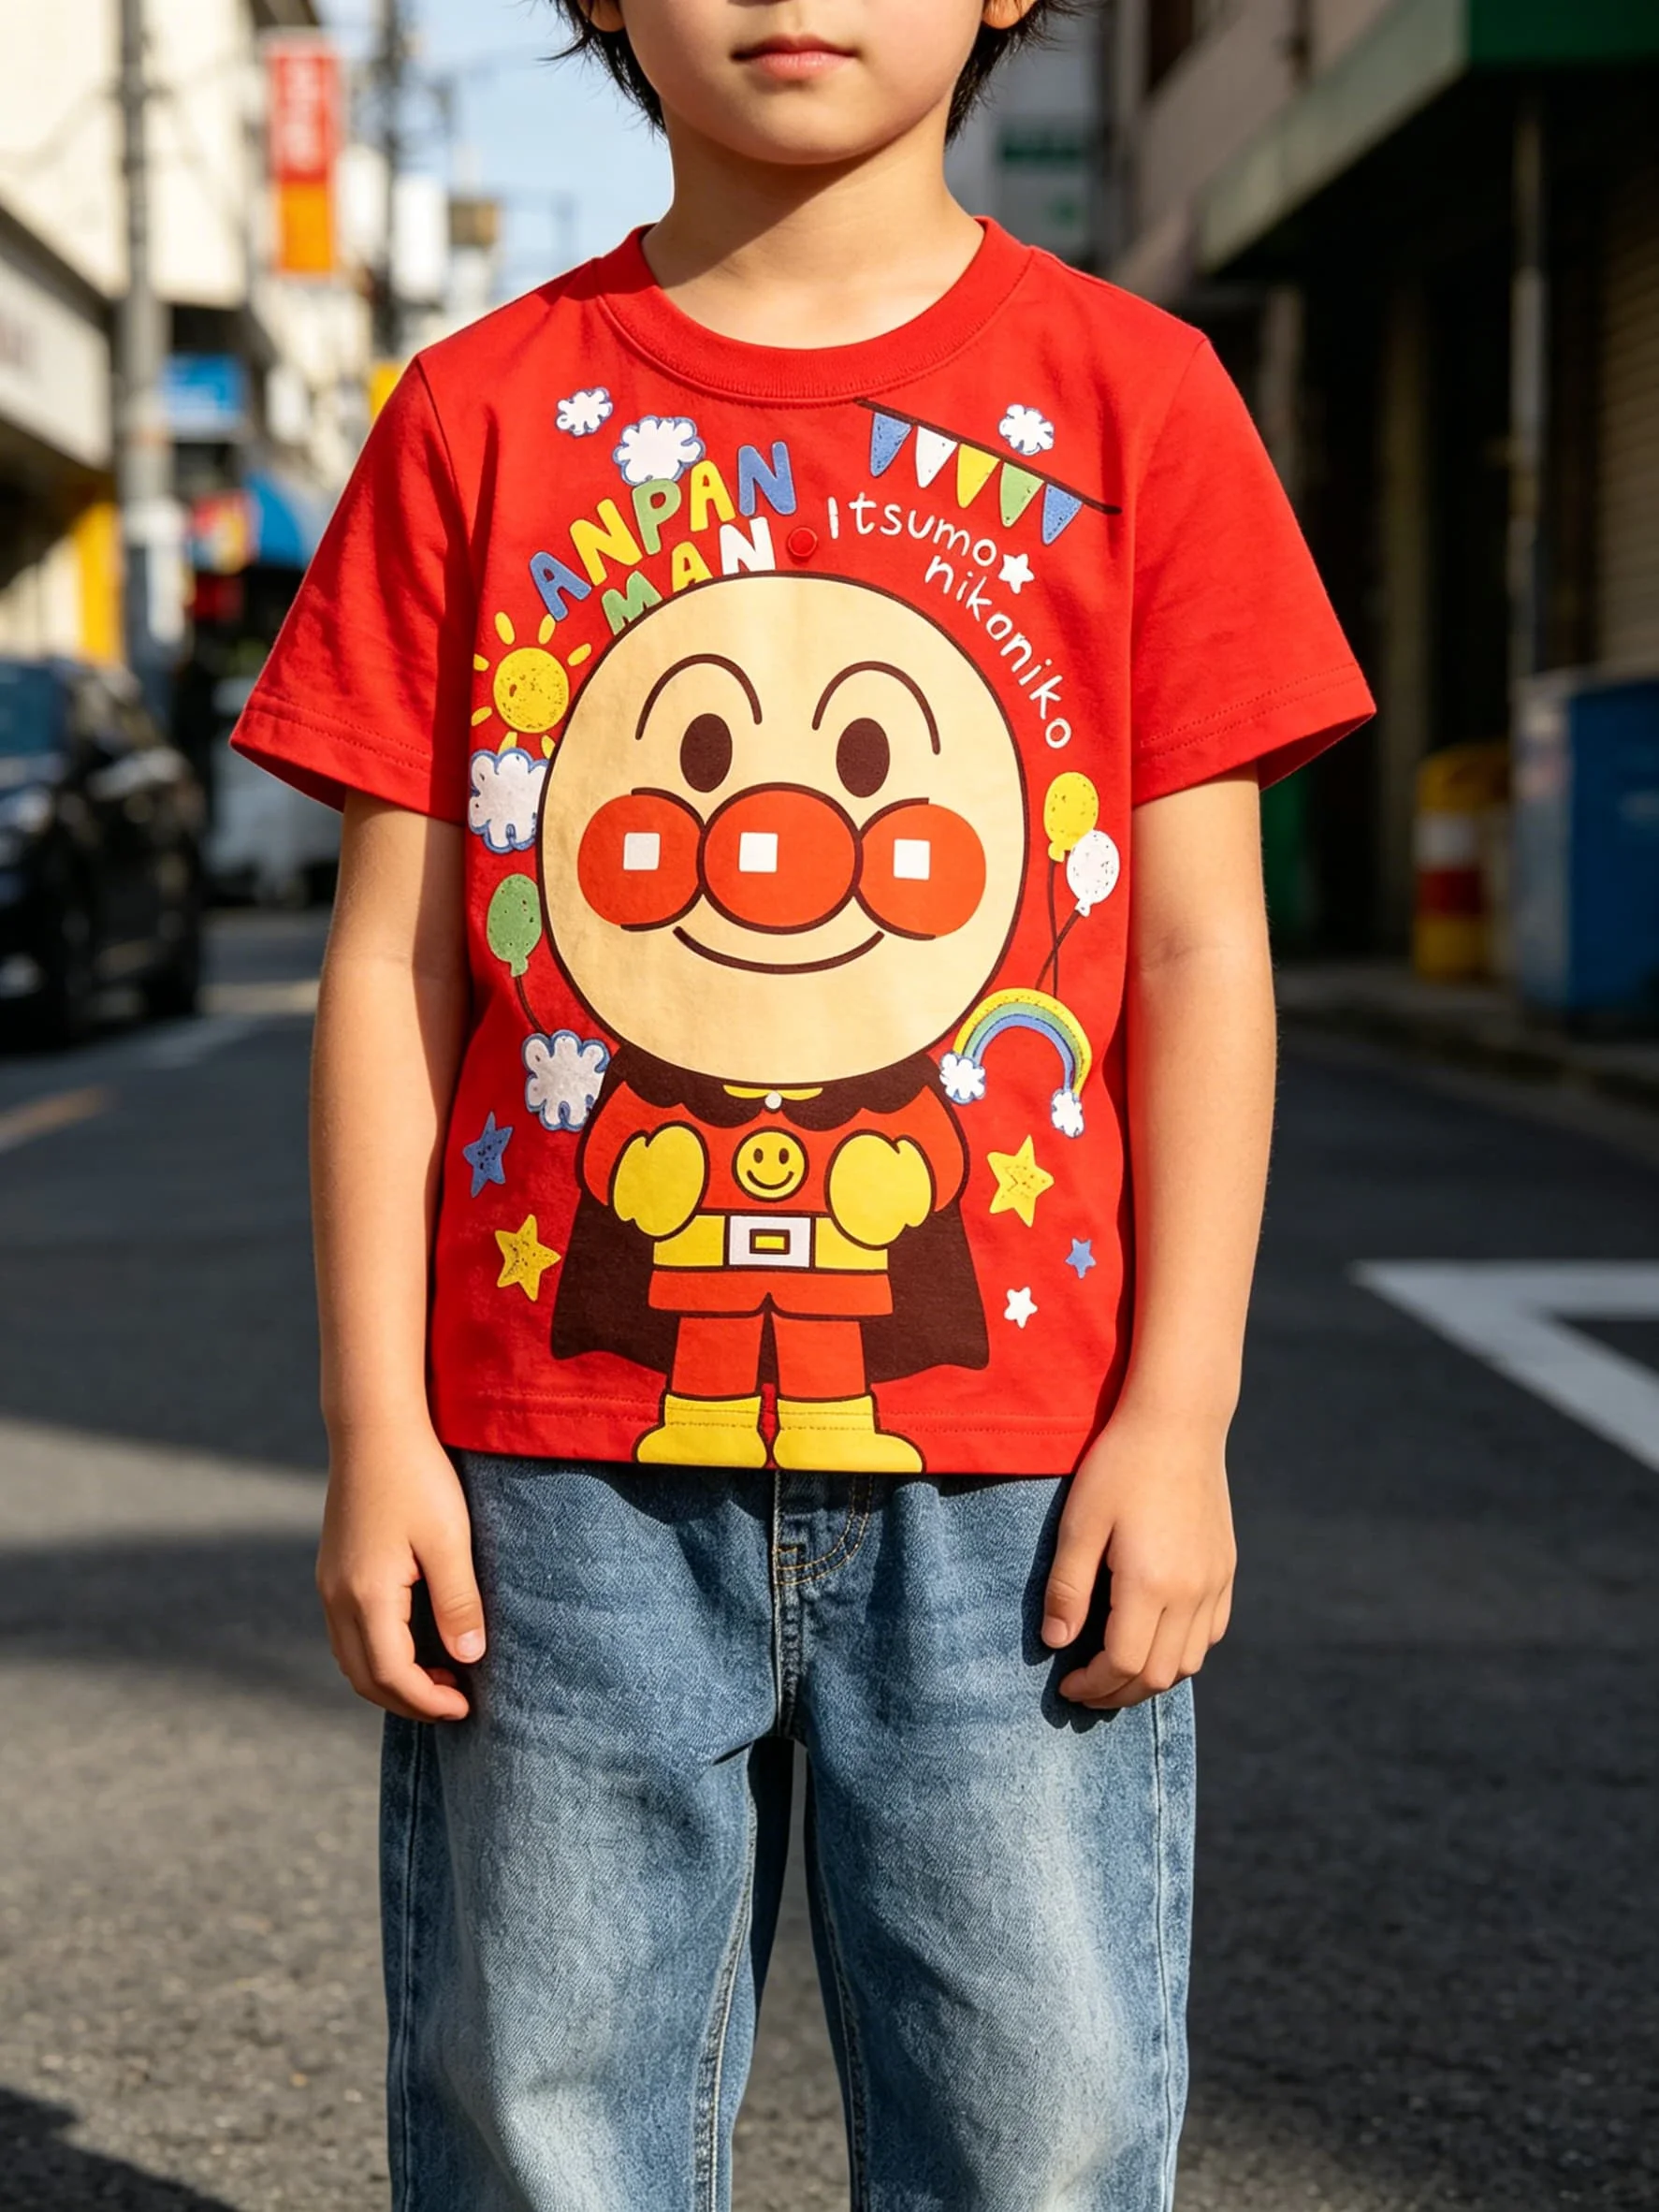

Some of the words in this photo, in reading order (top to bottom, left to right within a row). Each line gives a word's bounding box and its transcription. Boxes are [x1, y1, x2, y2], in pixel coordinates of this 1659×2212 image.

[529, 441, 797, 622] ANPAN
[601, 516, 776, 635] MAN
[827, 492, 998, 566] Itsumo
[924, 555, 1072, 749] nikoniko
